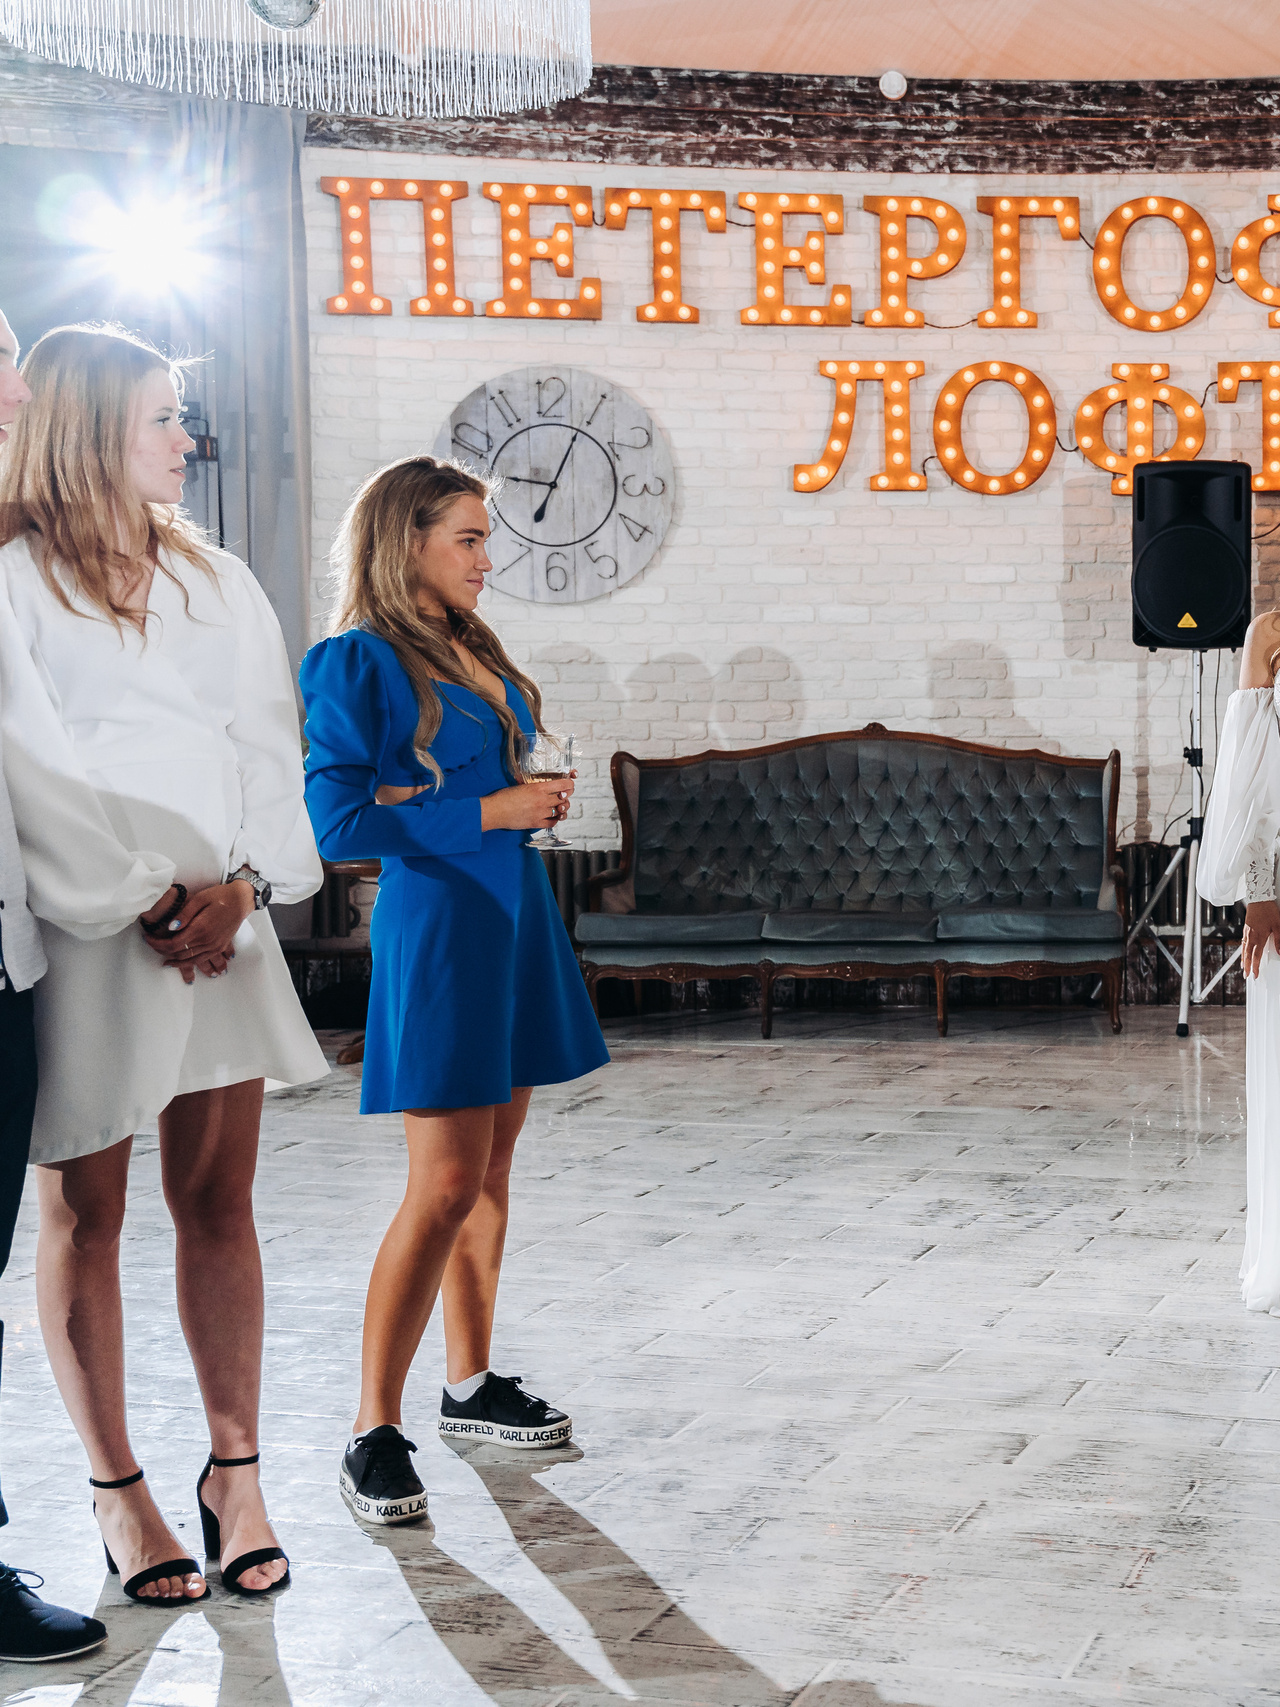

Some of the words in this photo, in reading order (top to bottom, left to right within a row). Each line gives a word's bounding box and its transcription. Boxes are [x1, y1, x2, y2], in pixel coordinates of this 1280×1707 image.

[535, 376, 566, 418] 12
[499, 1429, 525, 1442] KARL
[527, 1425, 572, 1442] LAGERF
[376, 1505, 407, 1517] KARL
